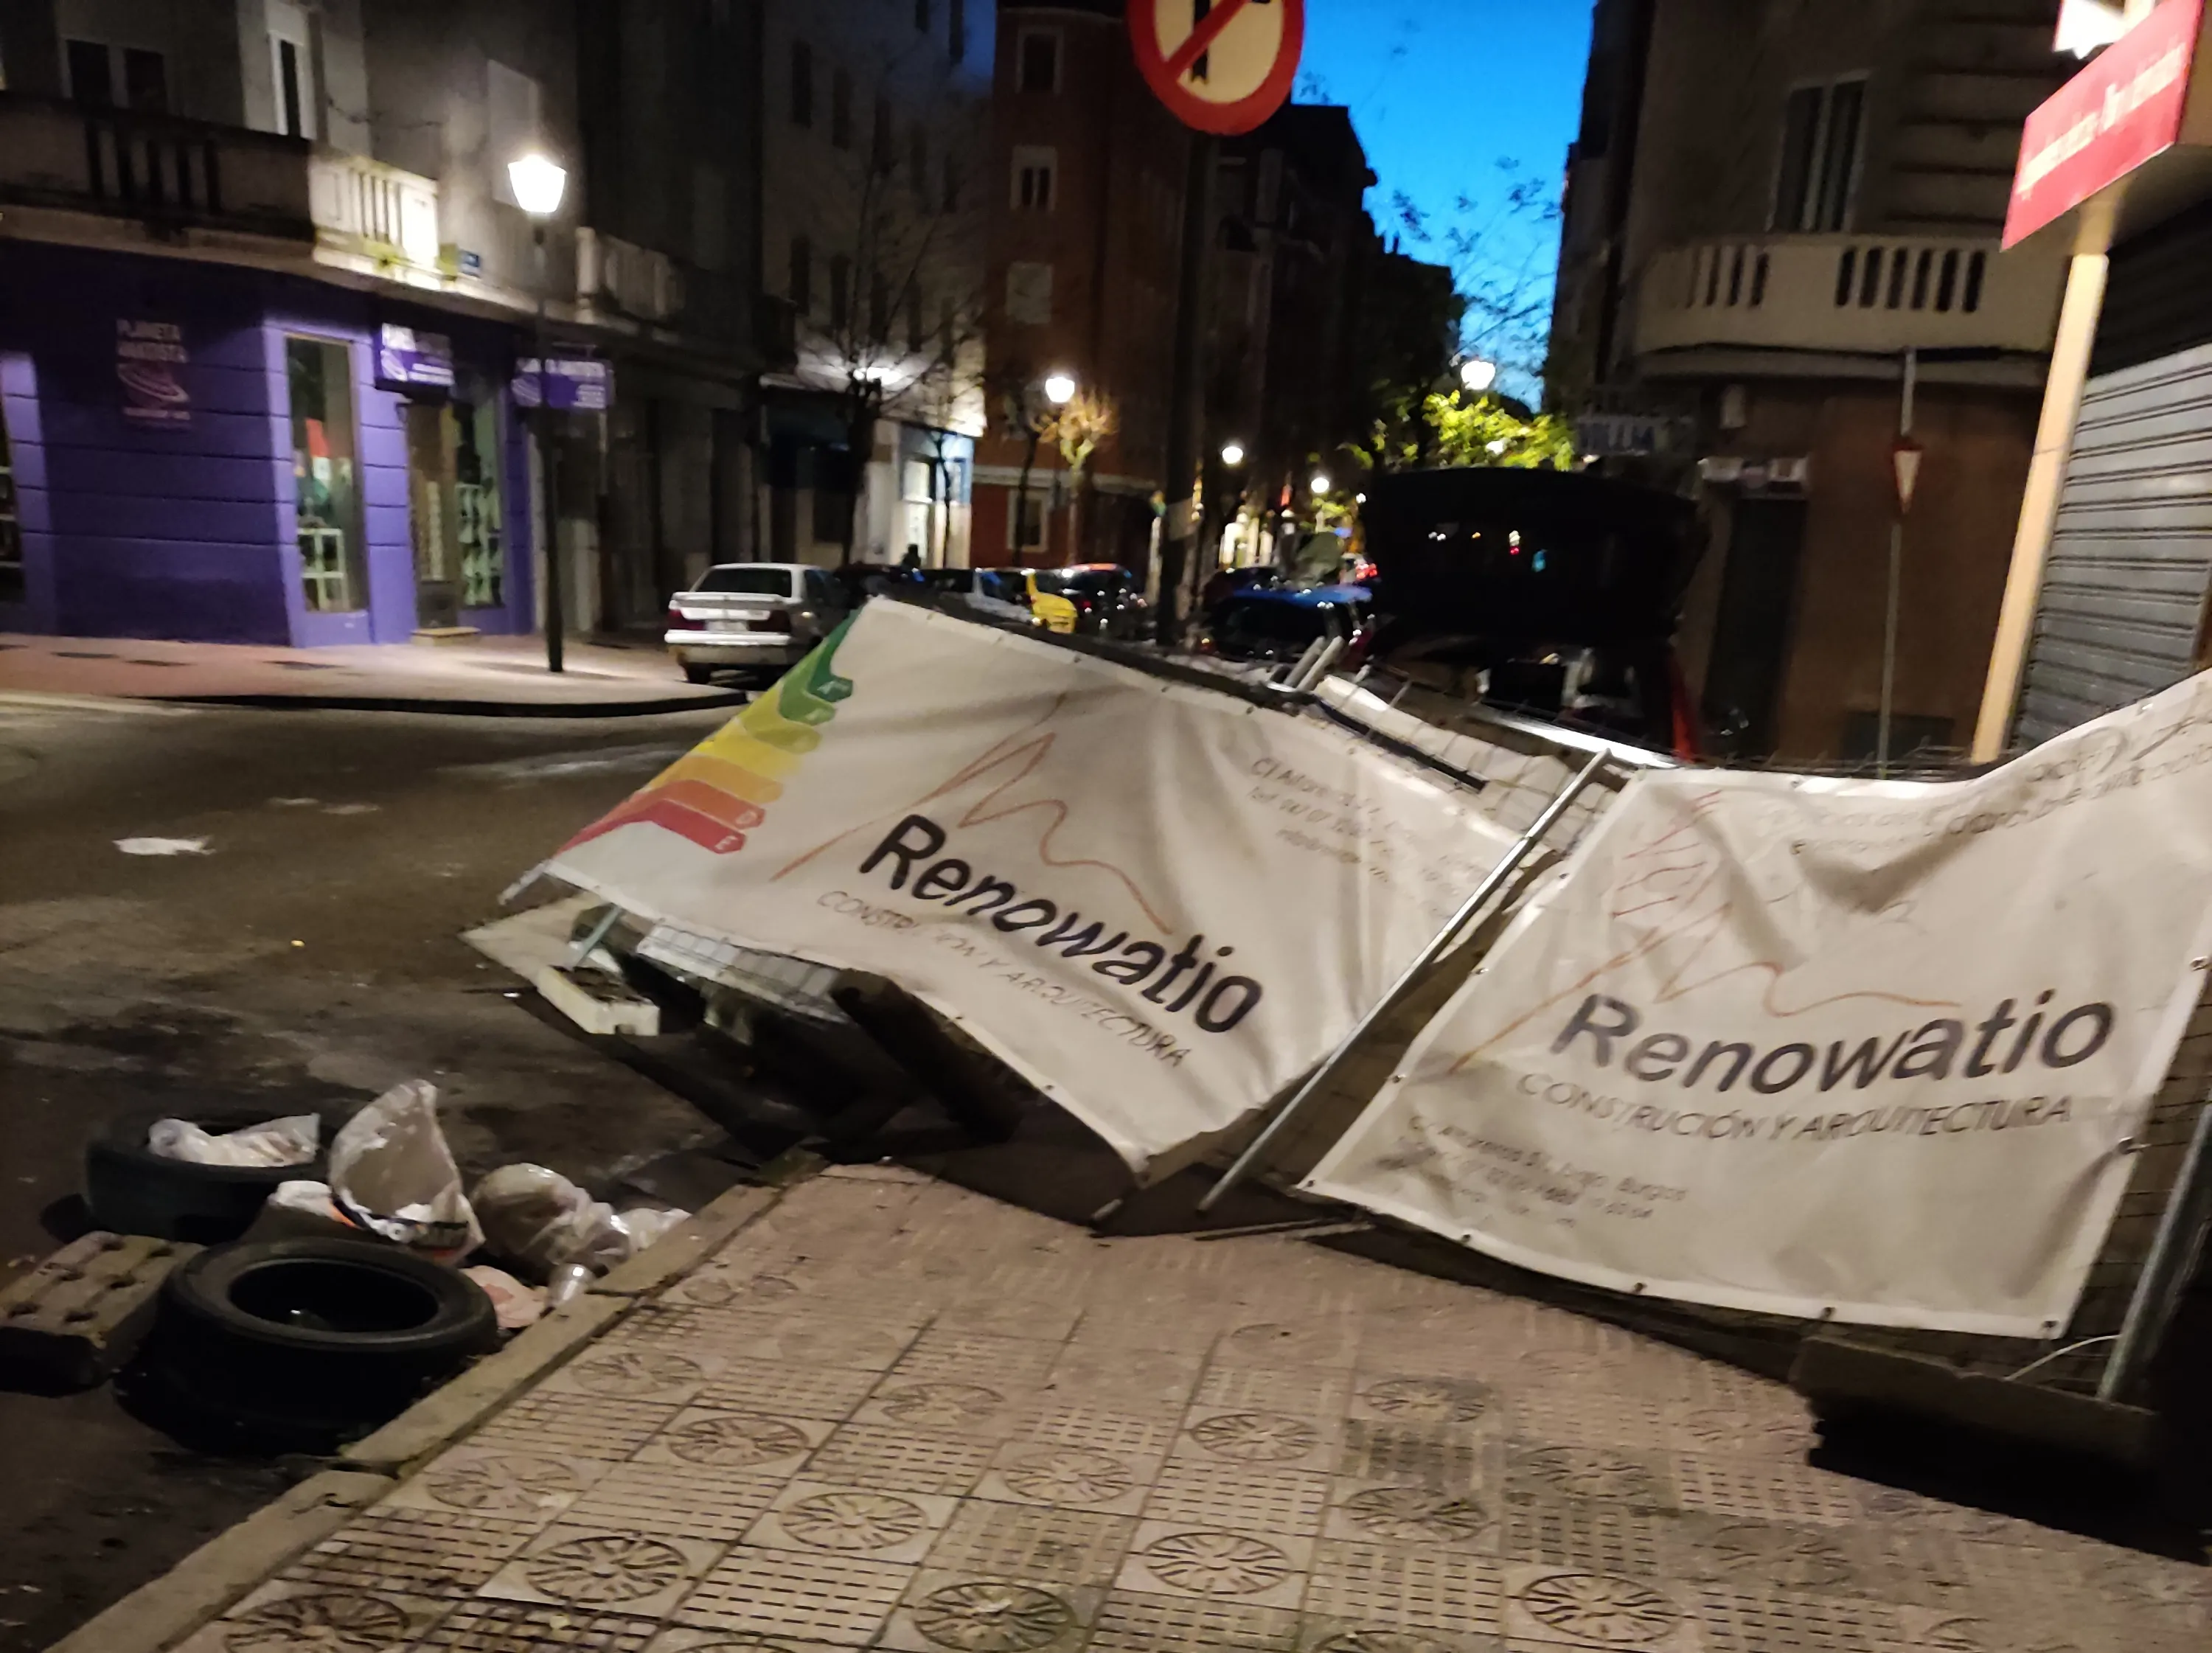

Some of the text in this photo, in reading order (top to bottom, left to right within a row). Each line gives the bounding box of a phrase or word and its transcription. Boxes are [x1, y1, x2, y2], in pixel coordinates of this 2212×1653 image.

[859, 814, 1262, 1032] Renowatio
[995, 972, 1192, 1067] ARQUITECTURA
[1549, 988, 2115, 1095] Renowatio
[1767, 1112, 1798, 1141] Y
[1792, 1095, 2073, 1140] ARQUITECTURA
